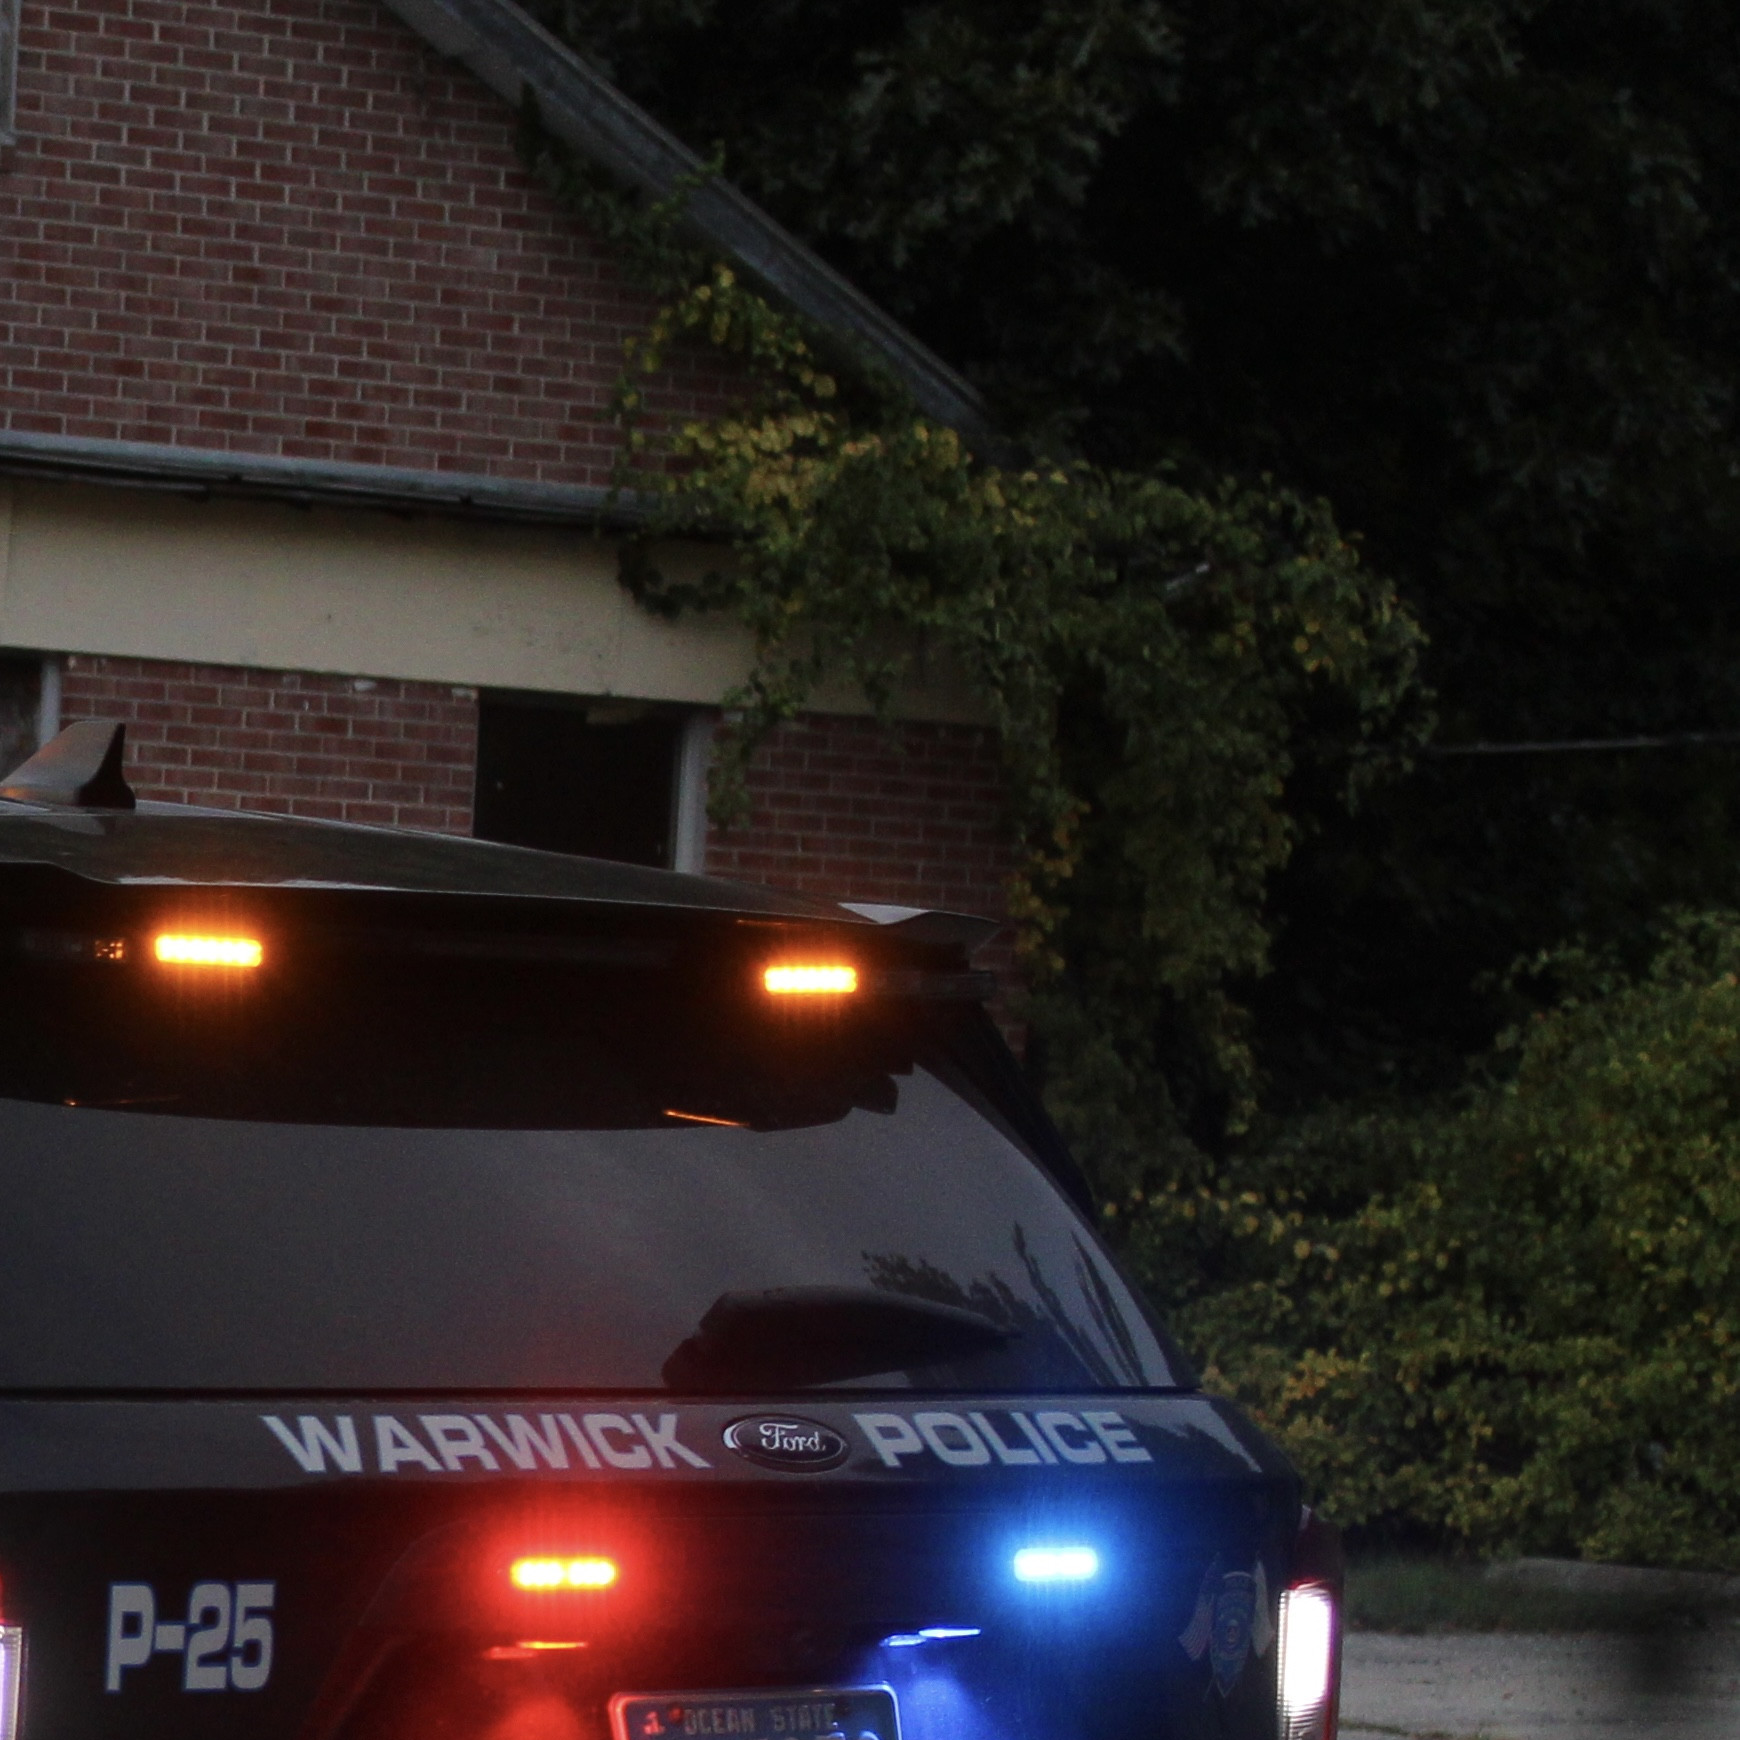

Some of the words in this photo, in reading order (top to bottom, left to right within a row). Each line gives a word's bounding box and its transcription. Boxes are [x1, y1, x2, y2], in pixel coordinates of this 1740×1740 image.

[262, 1412, 715, 1473] WARWICK
[759, 1422, 827, 1452] Ford
[853, 1411, 1155, 1468] POLICE
[105, 1580, 276, 1693] P-25
[683, 1706, 757, 1736] OCEAN
[772, 1702, 840, 1733] STATE
